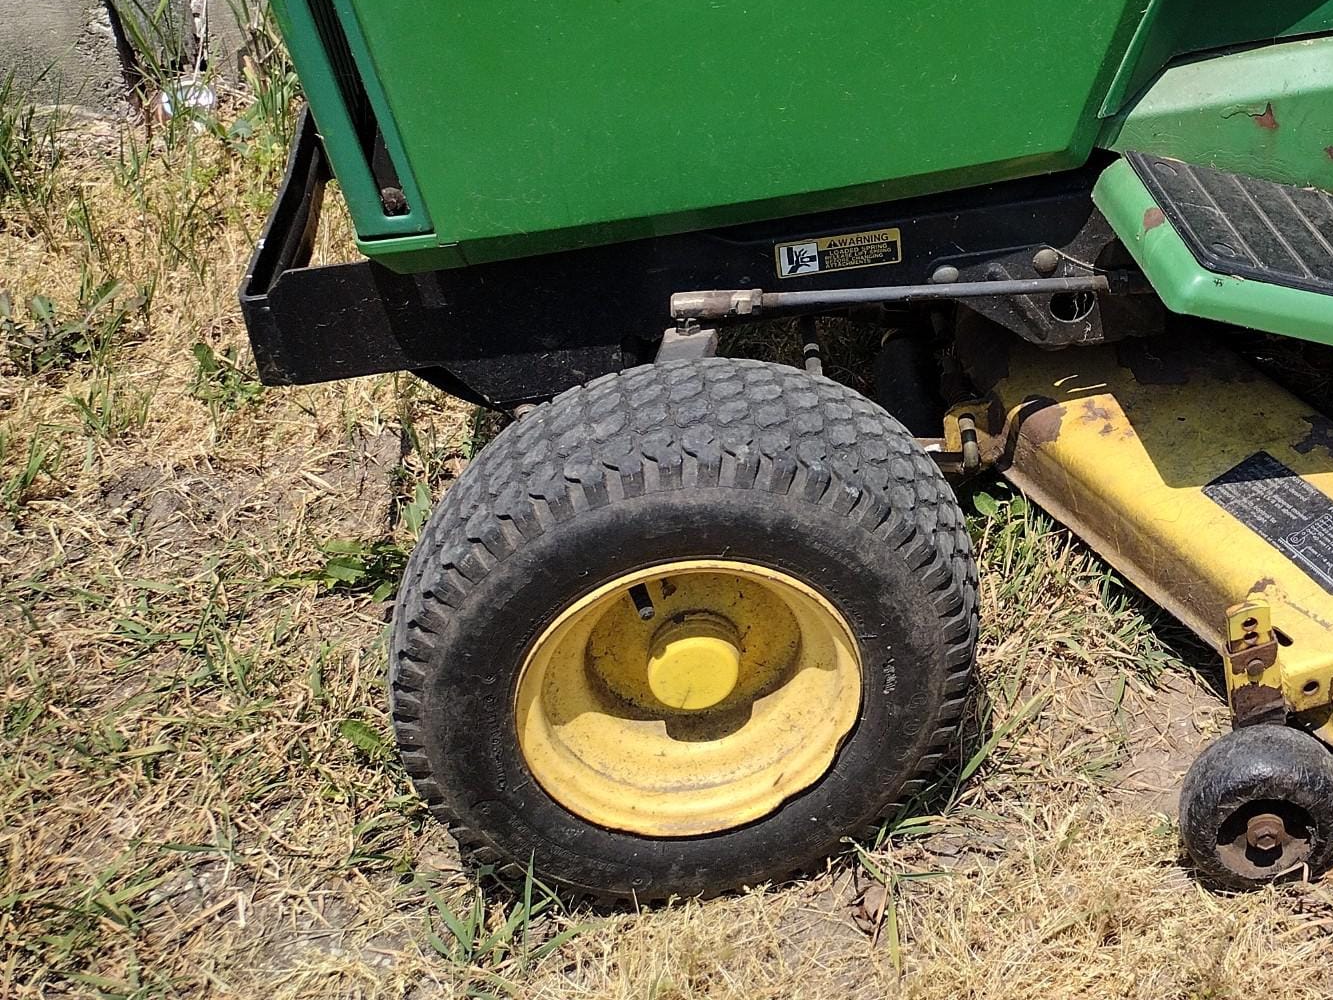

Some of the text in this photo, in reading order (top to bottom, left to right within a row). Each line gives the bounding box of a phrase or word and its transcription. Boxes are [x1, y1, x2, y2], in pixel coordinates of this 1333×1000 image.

[838, 233, 889, 246] WARNING
[829, 243, 888, 256] LOADED SPRING
